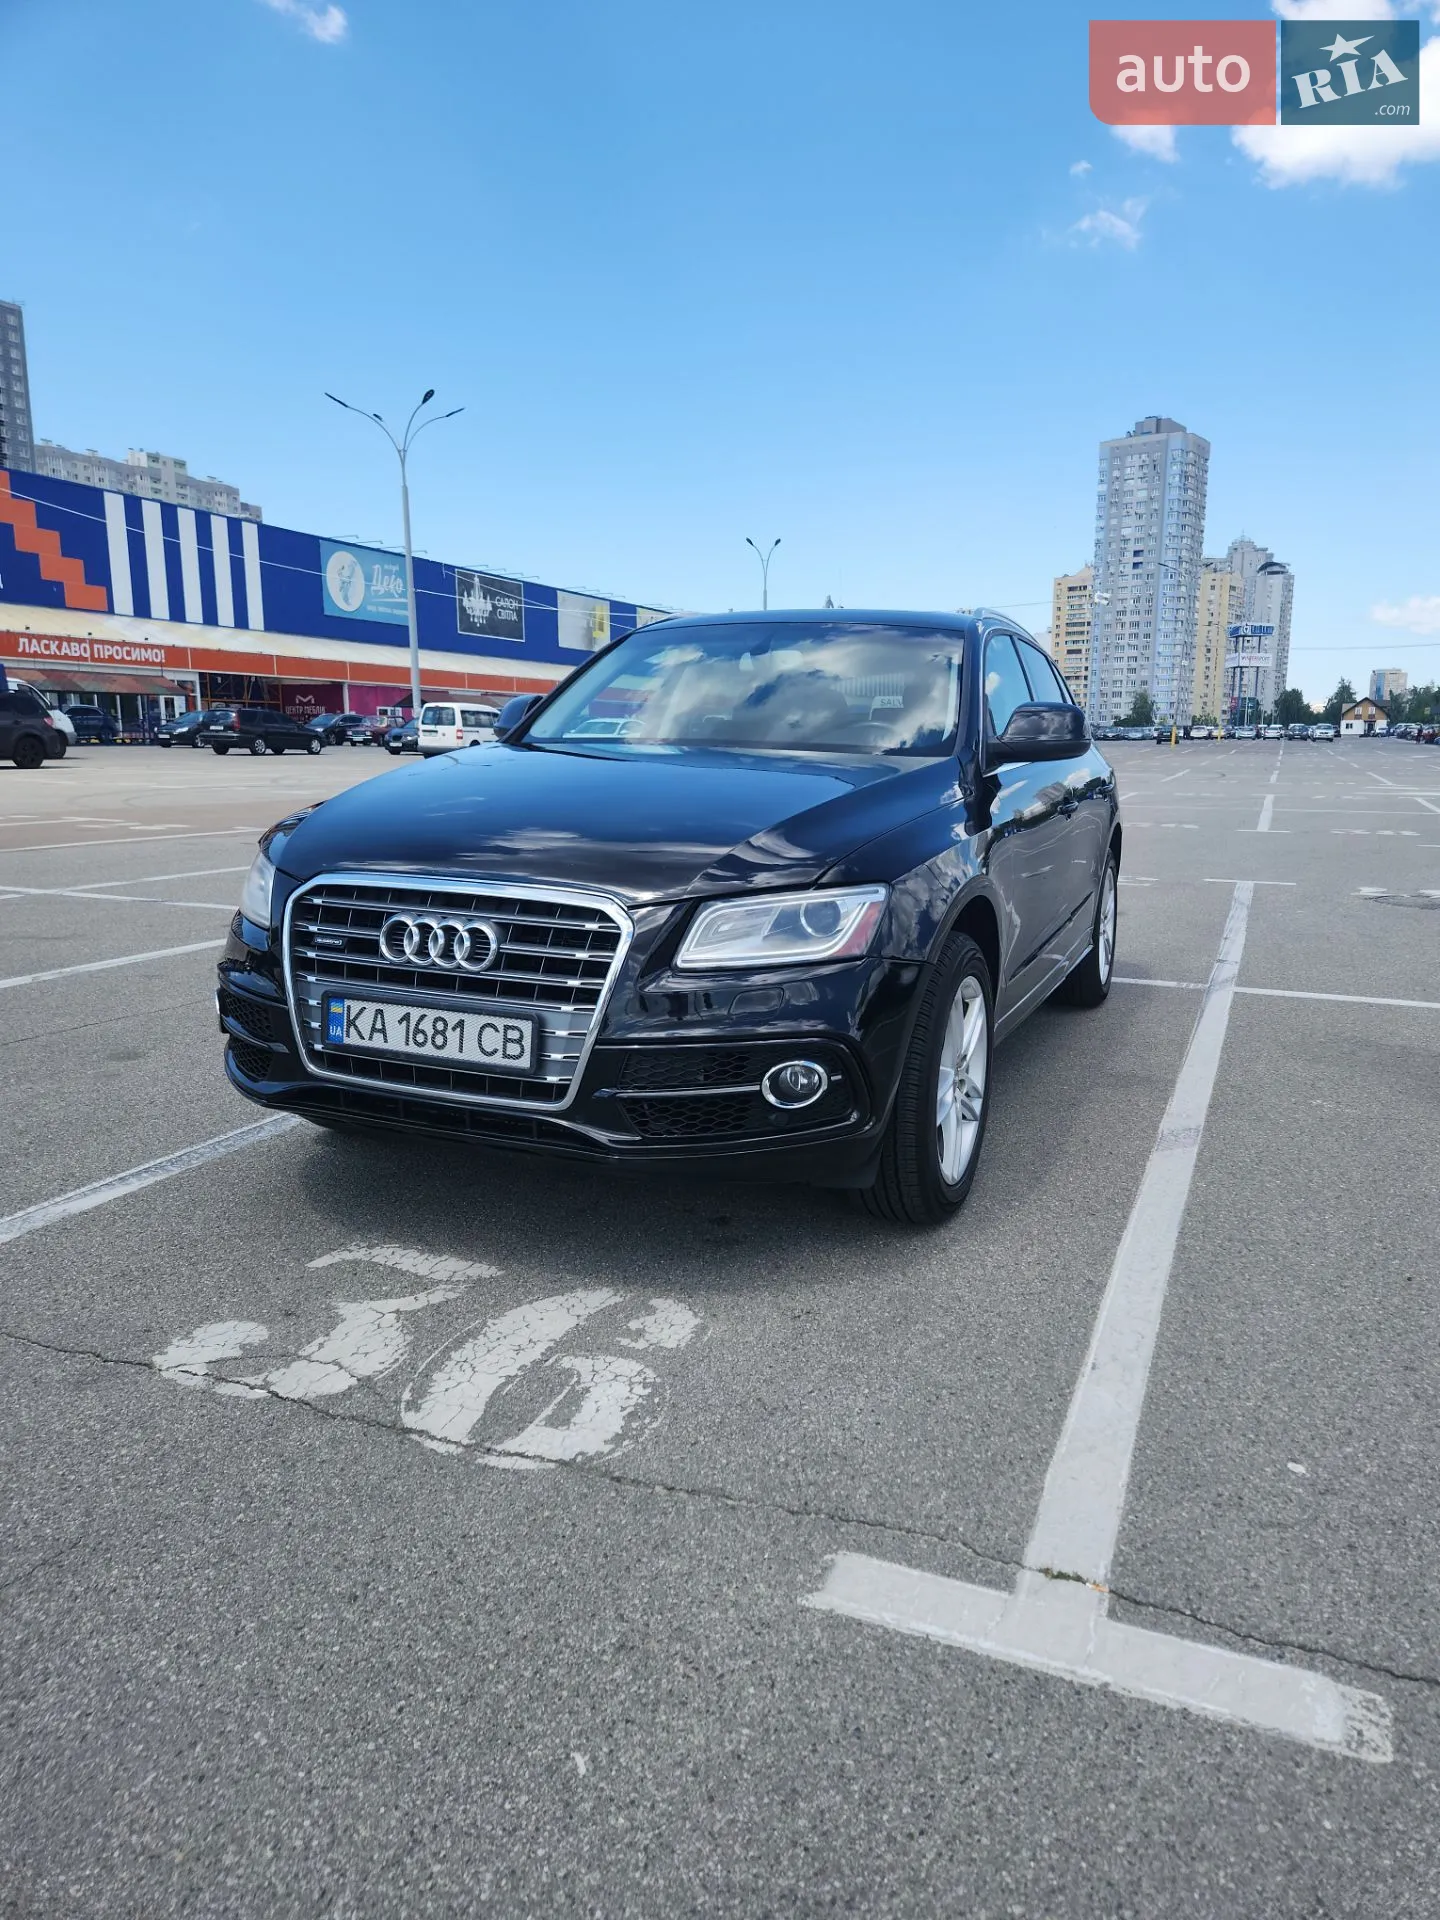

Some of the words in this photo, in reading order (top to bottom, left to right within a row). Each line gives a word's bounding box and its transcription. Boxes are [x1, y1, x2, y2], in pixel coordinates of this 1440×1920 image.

[18, 637, 90, 658] ЛАСКАВО
[93, 643, 165, 663] ПРОСИМО!
[329, 1025, 343, 1037] UA
[345, 1004, 389, 1043] KA
[398, 1011, 465, 1054] 1681
[477, 1022, 525, 1061] CB
